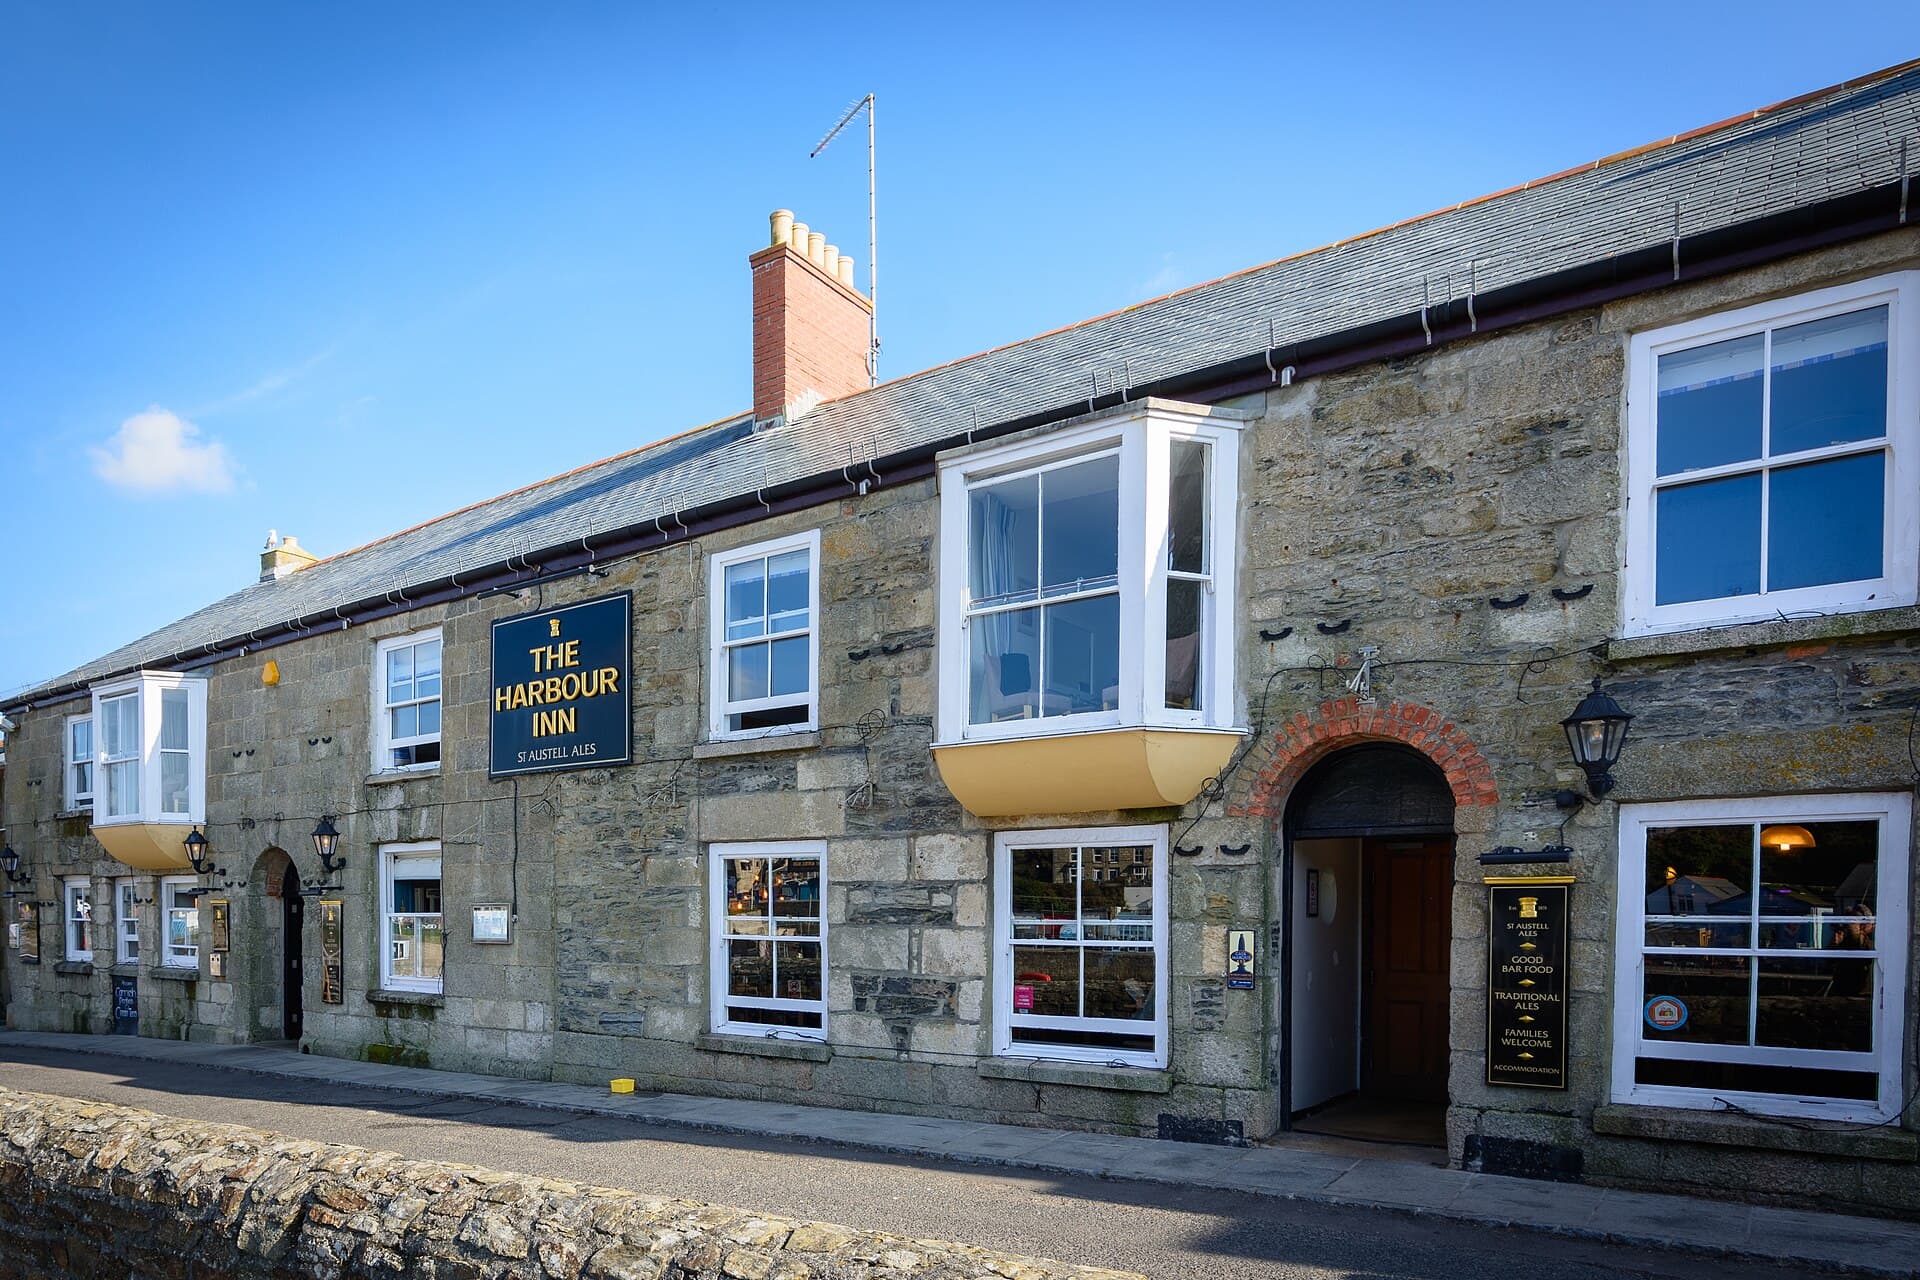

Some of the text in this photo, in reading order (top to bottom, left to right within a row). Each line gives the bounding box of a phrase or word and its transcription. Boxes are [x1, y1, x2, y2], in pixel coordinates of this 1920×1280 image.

[529, 639, 580, 673] THE
[495, 666, 619, 712] HARBOUR
[532, 707, 575, 737] INN
[528, 747, 568, 762] AUSTELL
[571, 743, 597, 757] ALES
[1511, 955, 1544, 964] GOOD
[1501, 965, 1554, 974] BAR FOOD
[1494, 991, 1561, 1002] TRADITIONAL
[1514, 1002, 1540, 1011] ALES
[1505, 1028, 1549, 1038] FAMILIES
[1501, 1038, 1553, 1049] WELCOME
[1493, 1064, 1560, 1074] ACCOMMODATION
